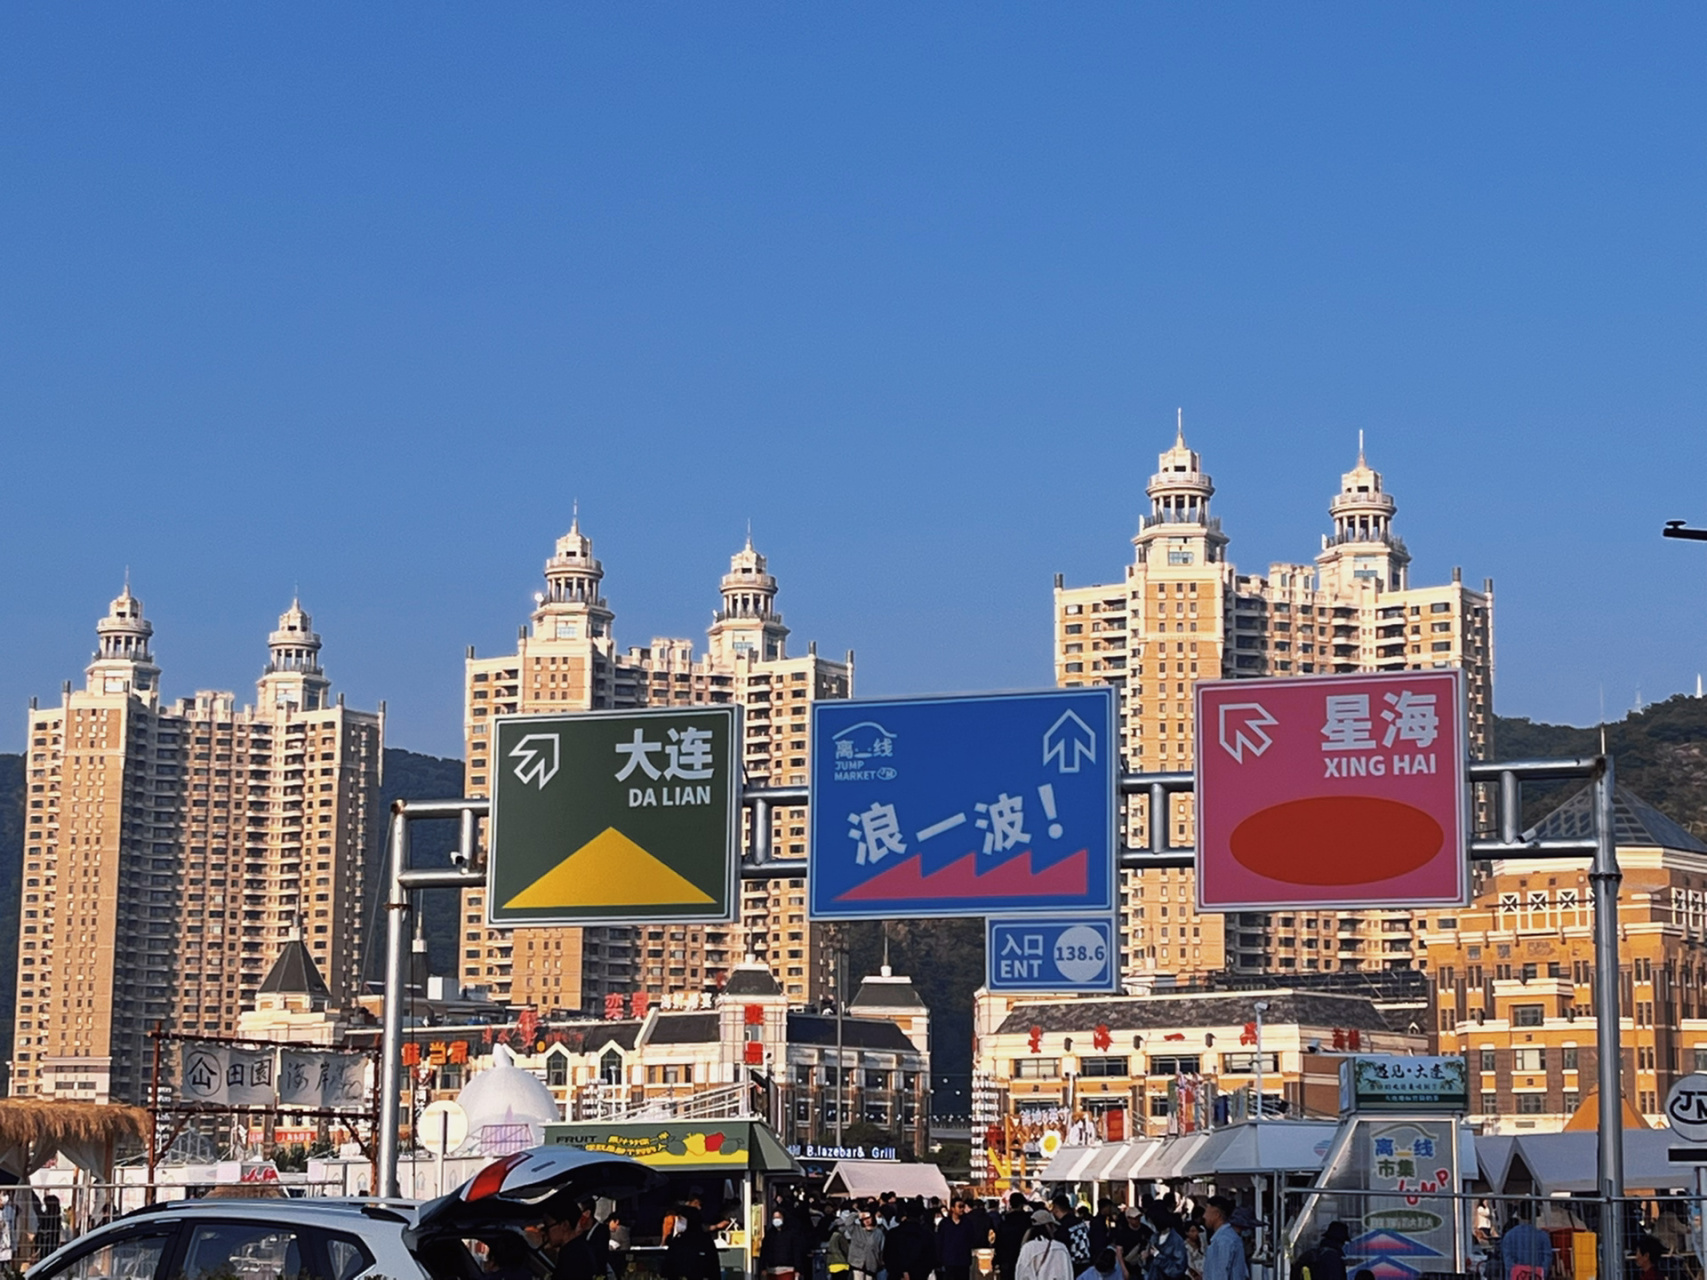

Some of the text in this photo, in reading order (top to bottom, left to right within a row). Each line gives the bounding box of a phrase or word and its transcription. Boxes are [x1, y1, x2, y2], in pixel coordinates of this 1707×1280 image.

[1320, 690, 1439, 751] 星海
[614, 726, 715, 782] 大连
[834, 760, 865, 771] JUMP
[1323, 753, 1436, 778] XING HAI
[834, 770, 877, 781] MARKET
[628, 786, 711, 807] DA LIAN
[1001, 934, 1043, 957] 入口
[1056, 945, 1105, 962] 138.6
[1001, 960, 1043, 979] ENT
[555, 1135, 598, 1144] FRUIT
[871, 1146, 897, 1160] Grill
[1376, 1158, 1416, 1178] 市集
